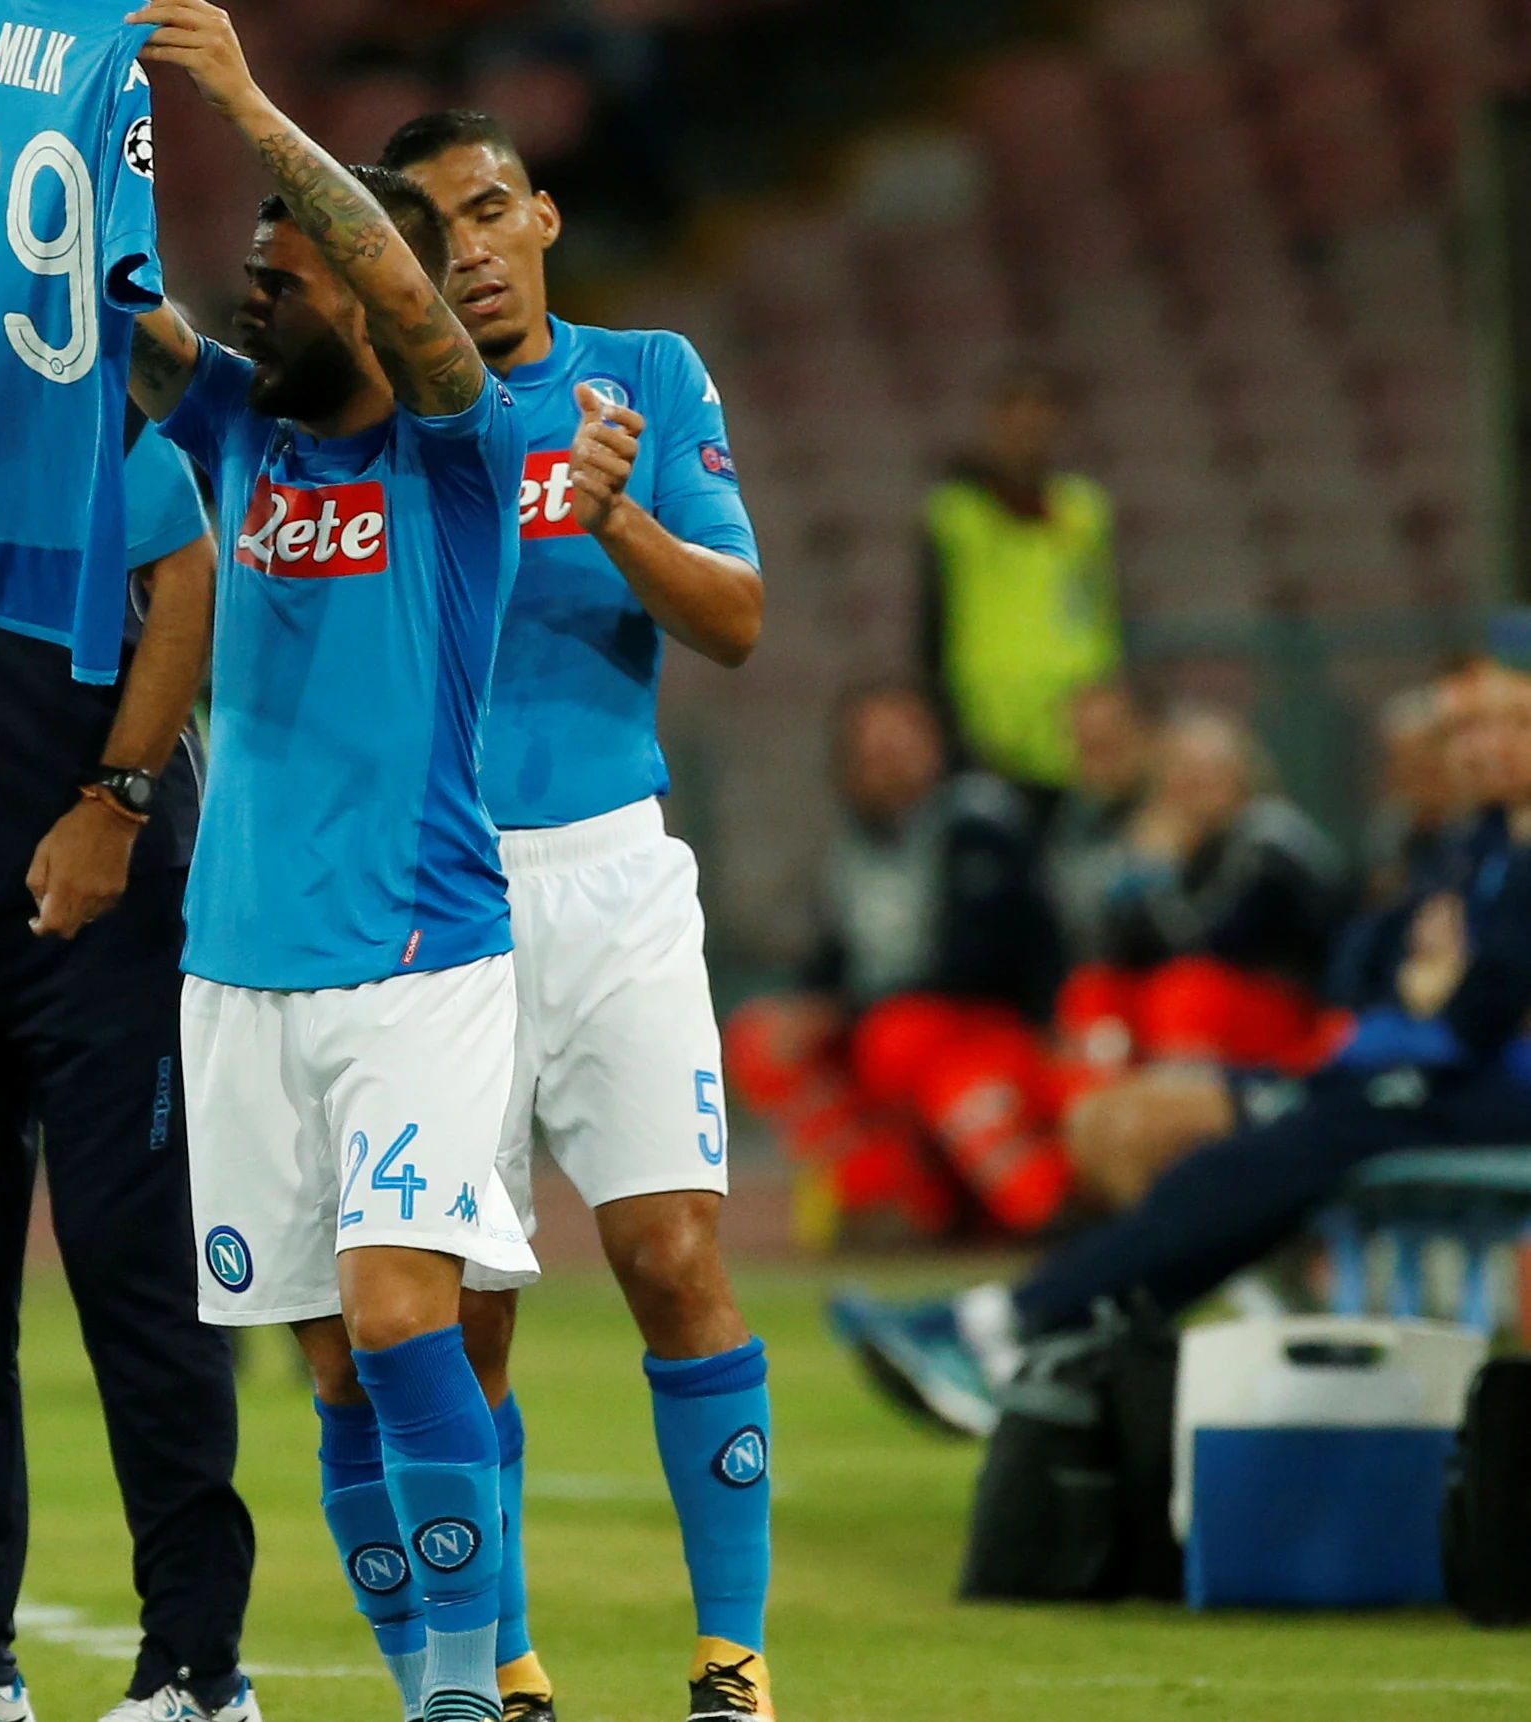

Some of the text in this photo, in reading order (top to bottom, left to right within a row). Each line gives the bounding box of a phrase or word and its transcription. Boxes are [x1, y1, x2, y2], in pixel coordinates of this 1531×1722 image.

[520, 462, 573, 525] et
[238, 493, 384, 563] Lete
[694, 1069, 724, 1165] 5
[340, 1123, 427, 1230] 24
[214, 1244, 240, 1275] N
[734, 1441, 757, 1473] N
[432, 1529, 459, 1558] N
[364, 1555, 392, 1582] N
